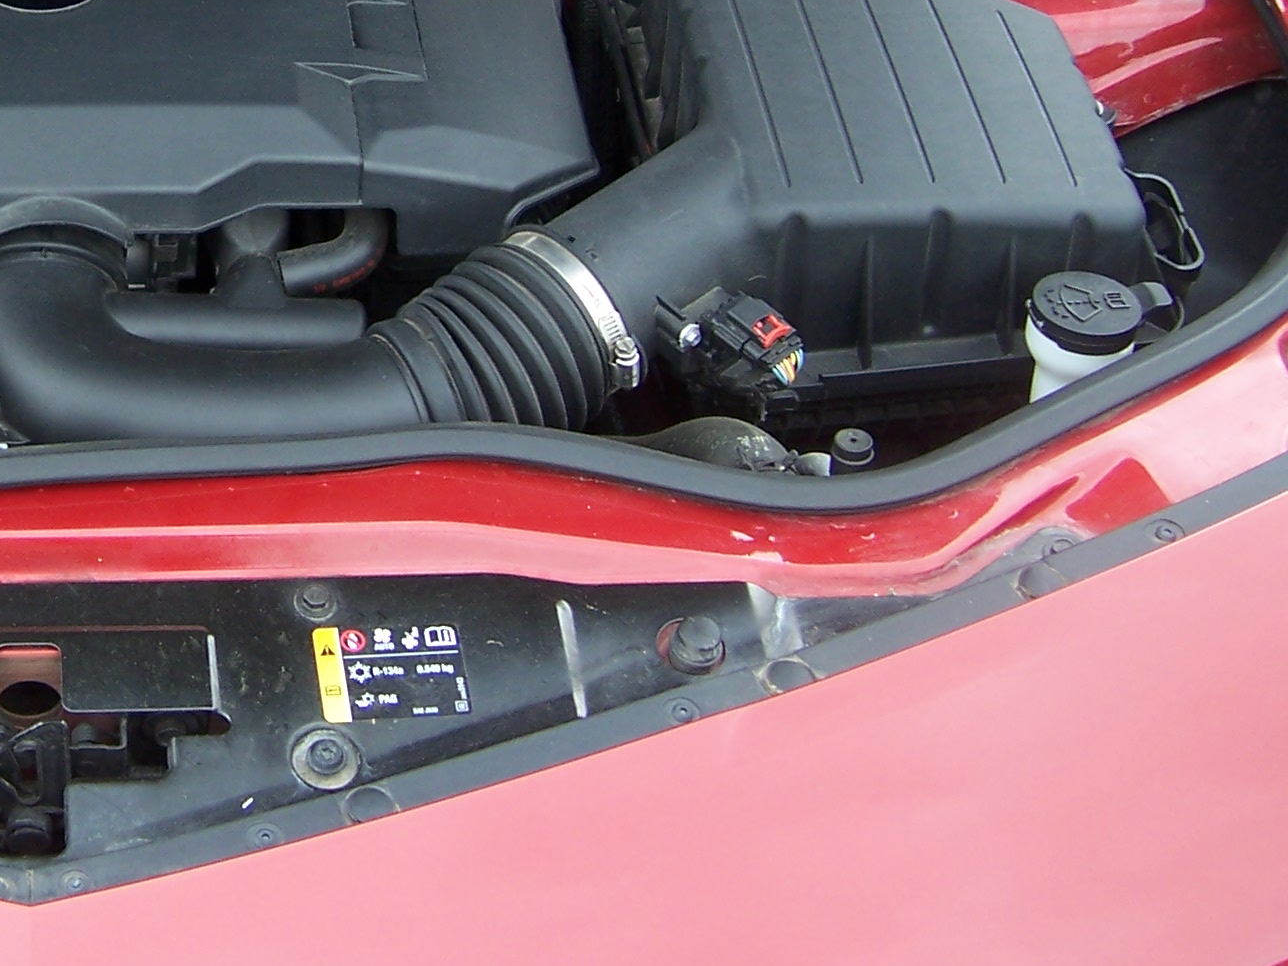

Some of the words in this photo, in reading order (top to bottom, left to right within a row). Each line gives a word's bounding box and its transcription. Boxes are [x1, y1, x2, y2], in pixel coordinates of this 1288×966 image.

[372, 665, 405, 676] R-134a
[441, 663, 454, 674] kg
[378, 693, 399, 704] PAG
